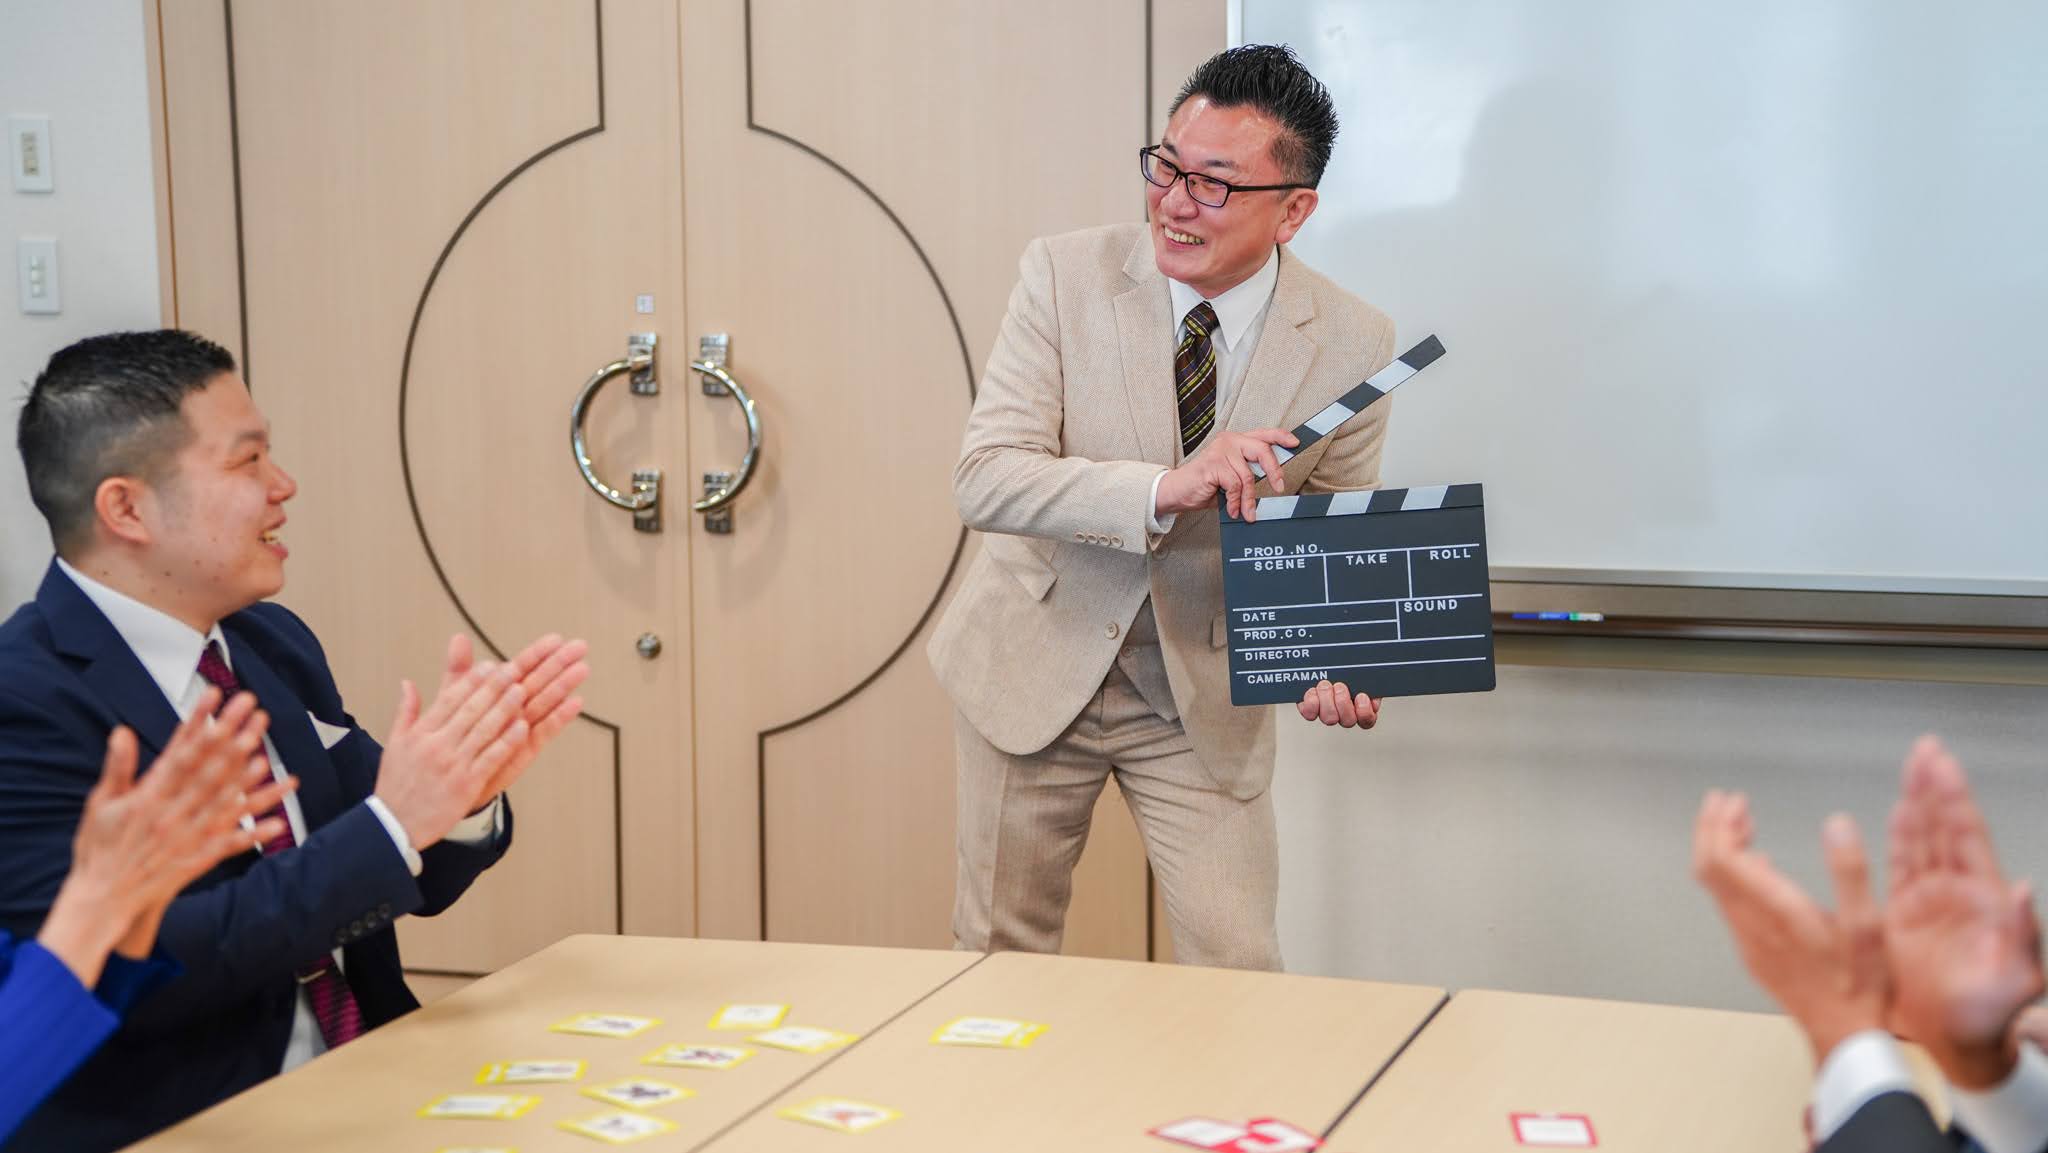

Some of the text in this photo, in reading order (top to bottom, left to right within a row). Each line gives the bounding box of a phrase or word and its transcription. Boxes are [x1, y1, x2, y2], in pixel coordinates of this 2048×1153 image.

[1346, 553, 1388, 565] TAKE
[1430, 549, 1471, 560] ROLL
[1254, 559, 1306, 572] SCENE
[1404, 599, 1458, 612] SOUND
[1243, 612, 1276, 623] DATE
[1245, 649, 1310, 661] DIRECTOR
[1247, 671, 1328, 684] CAMERAMAN
